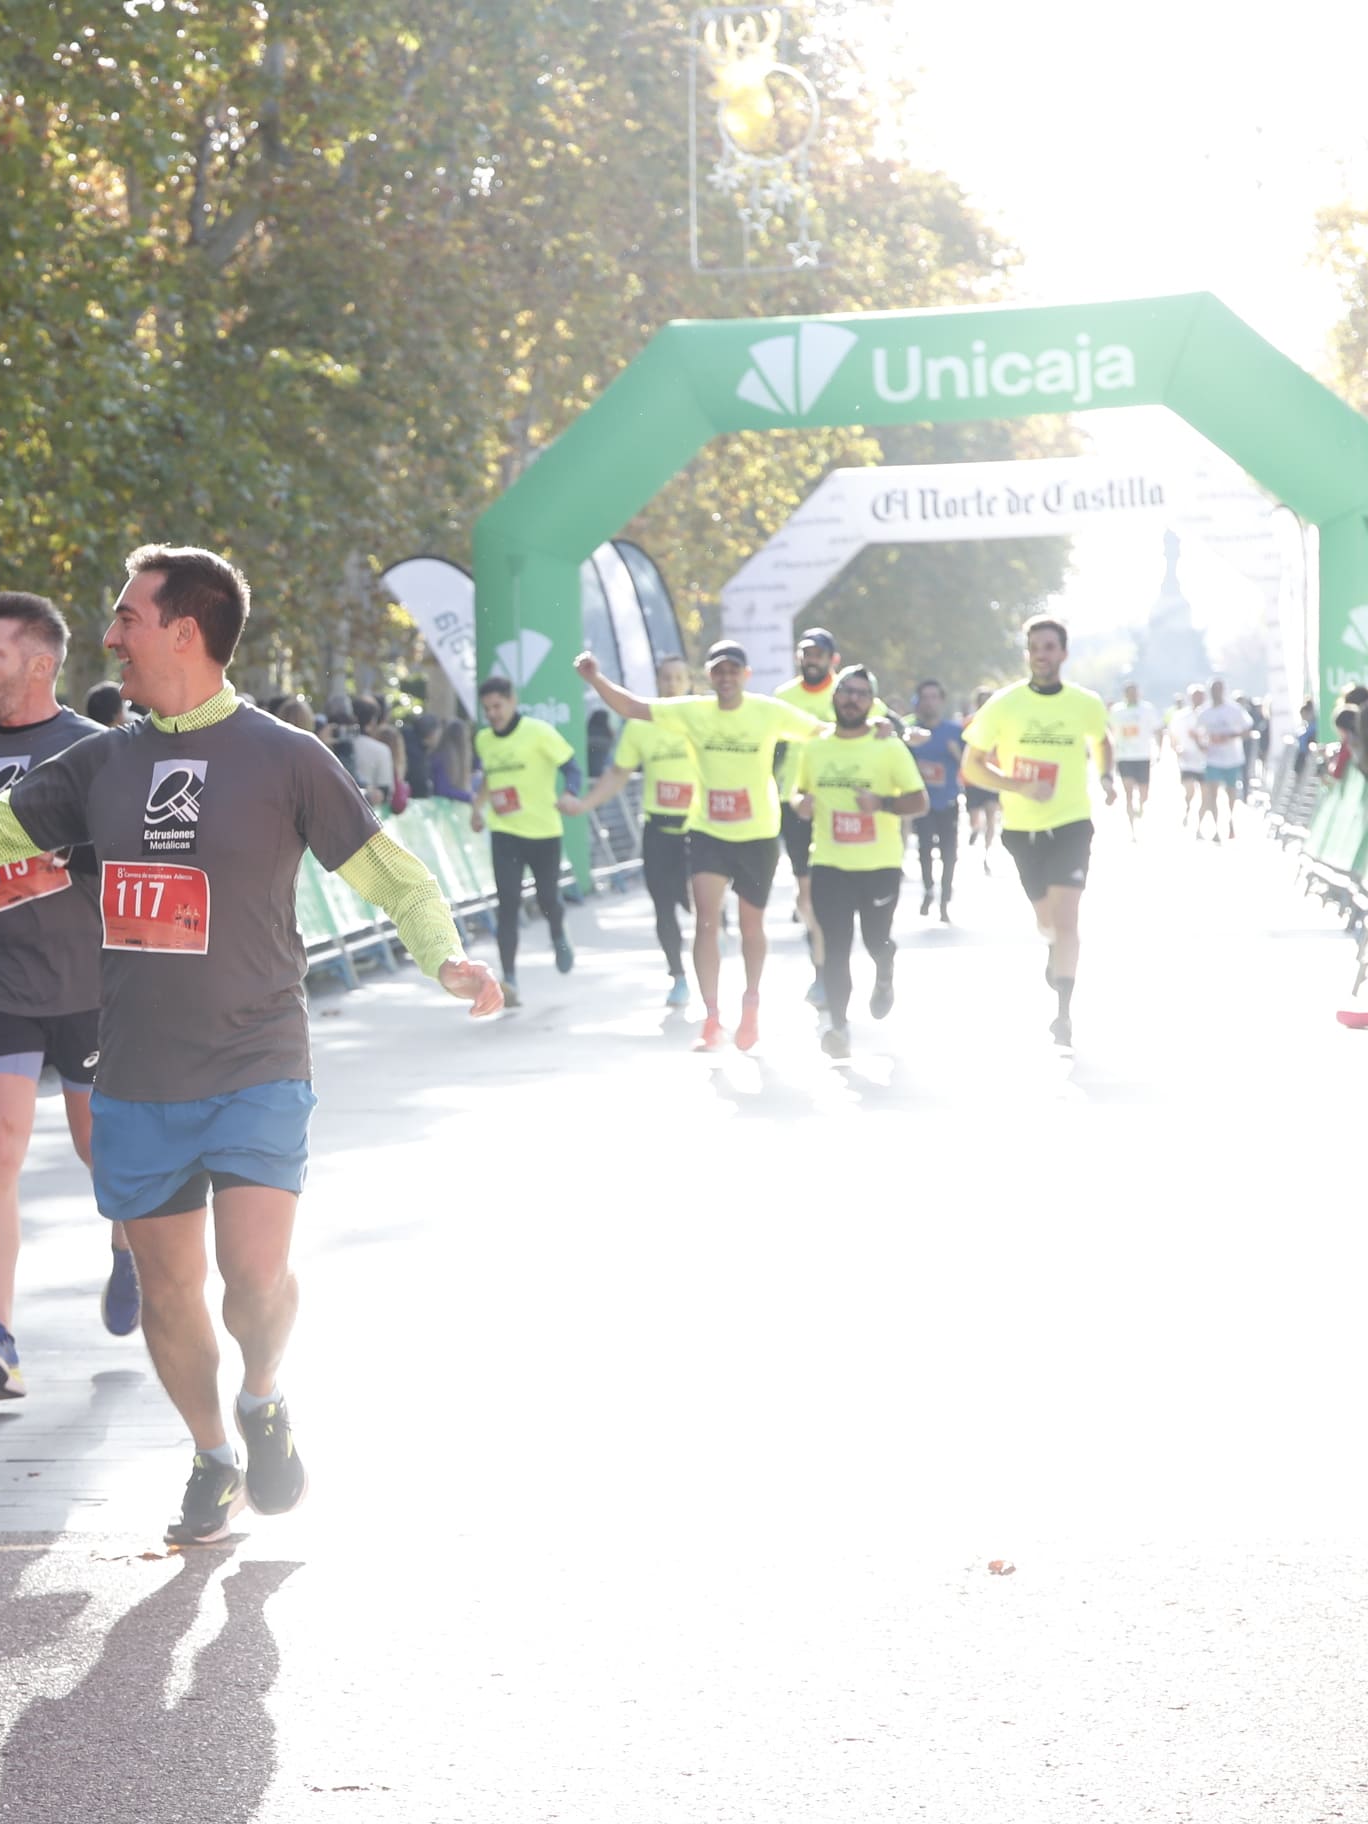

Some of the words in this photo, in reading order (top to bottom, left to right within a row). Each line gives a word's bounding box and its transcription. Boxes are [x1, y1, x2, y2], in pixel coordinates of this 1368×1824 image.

[872, 333, 1136, 404] Unicaja
[871, 489, 910, 523] El
[918, 488, 996, 520] Norte
[1005, 486, 1035, 516] de
[1042, 476, 1166, 513] Castilla
[143, 829, 195, 840] Extrusiones
[116, 880, 165, 918] 117
